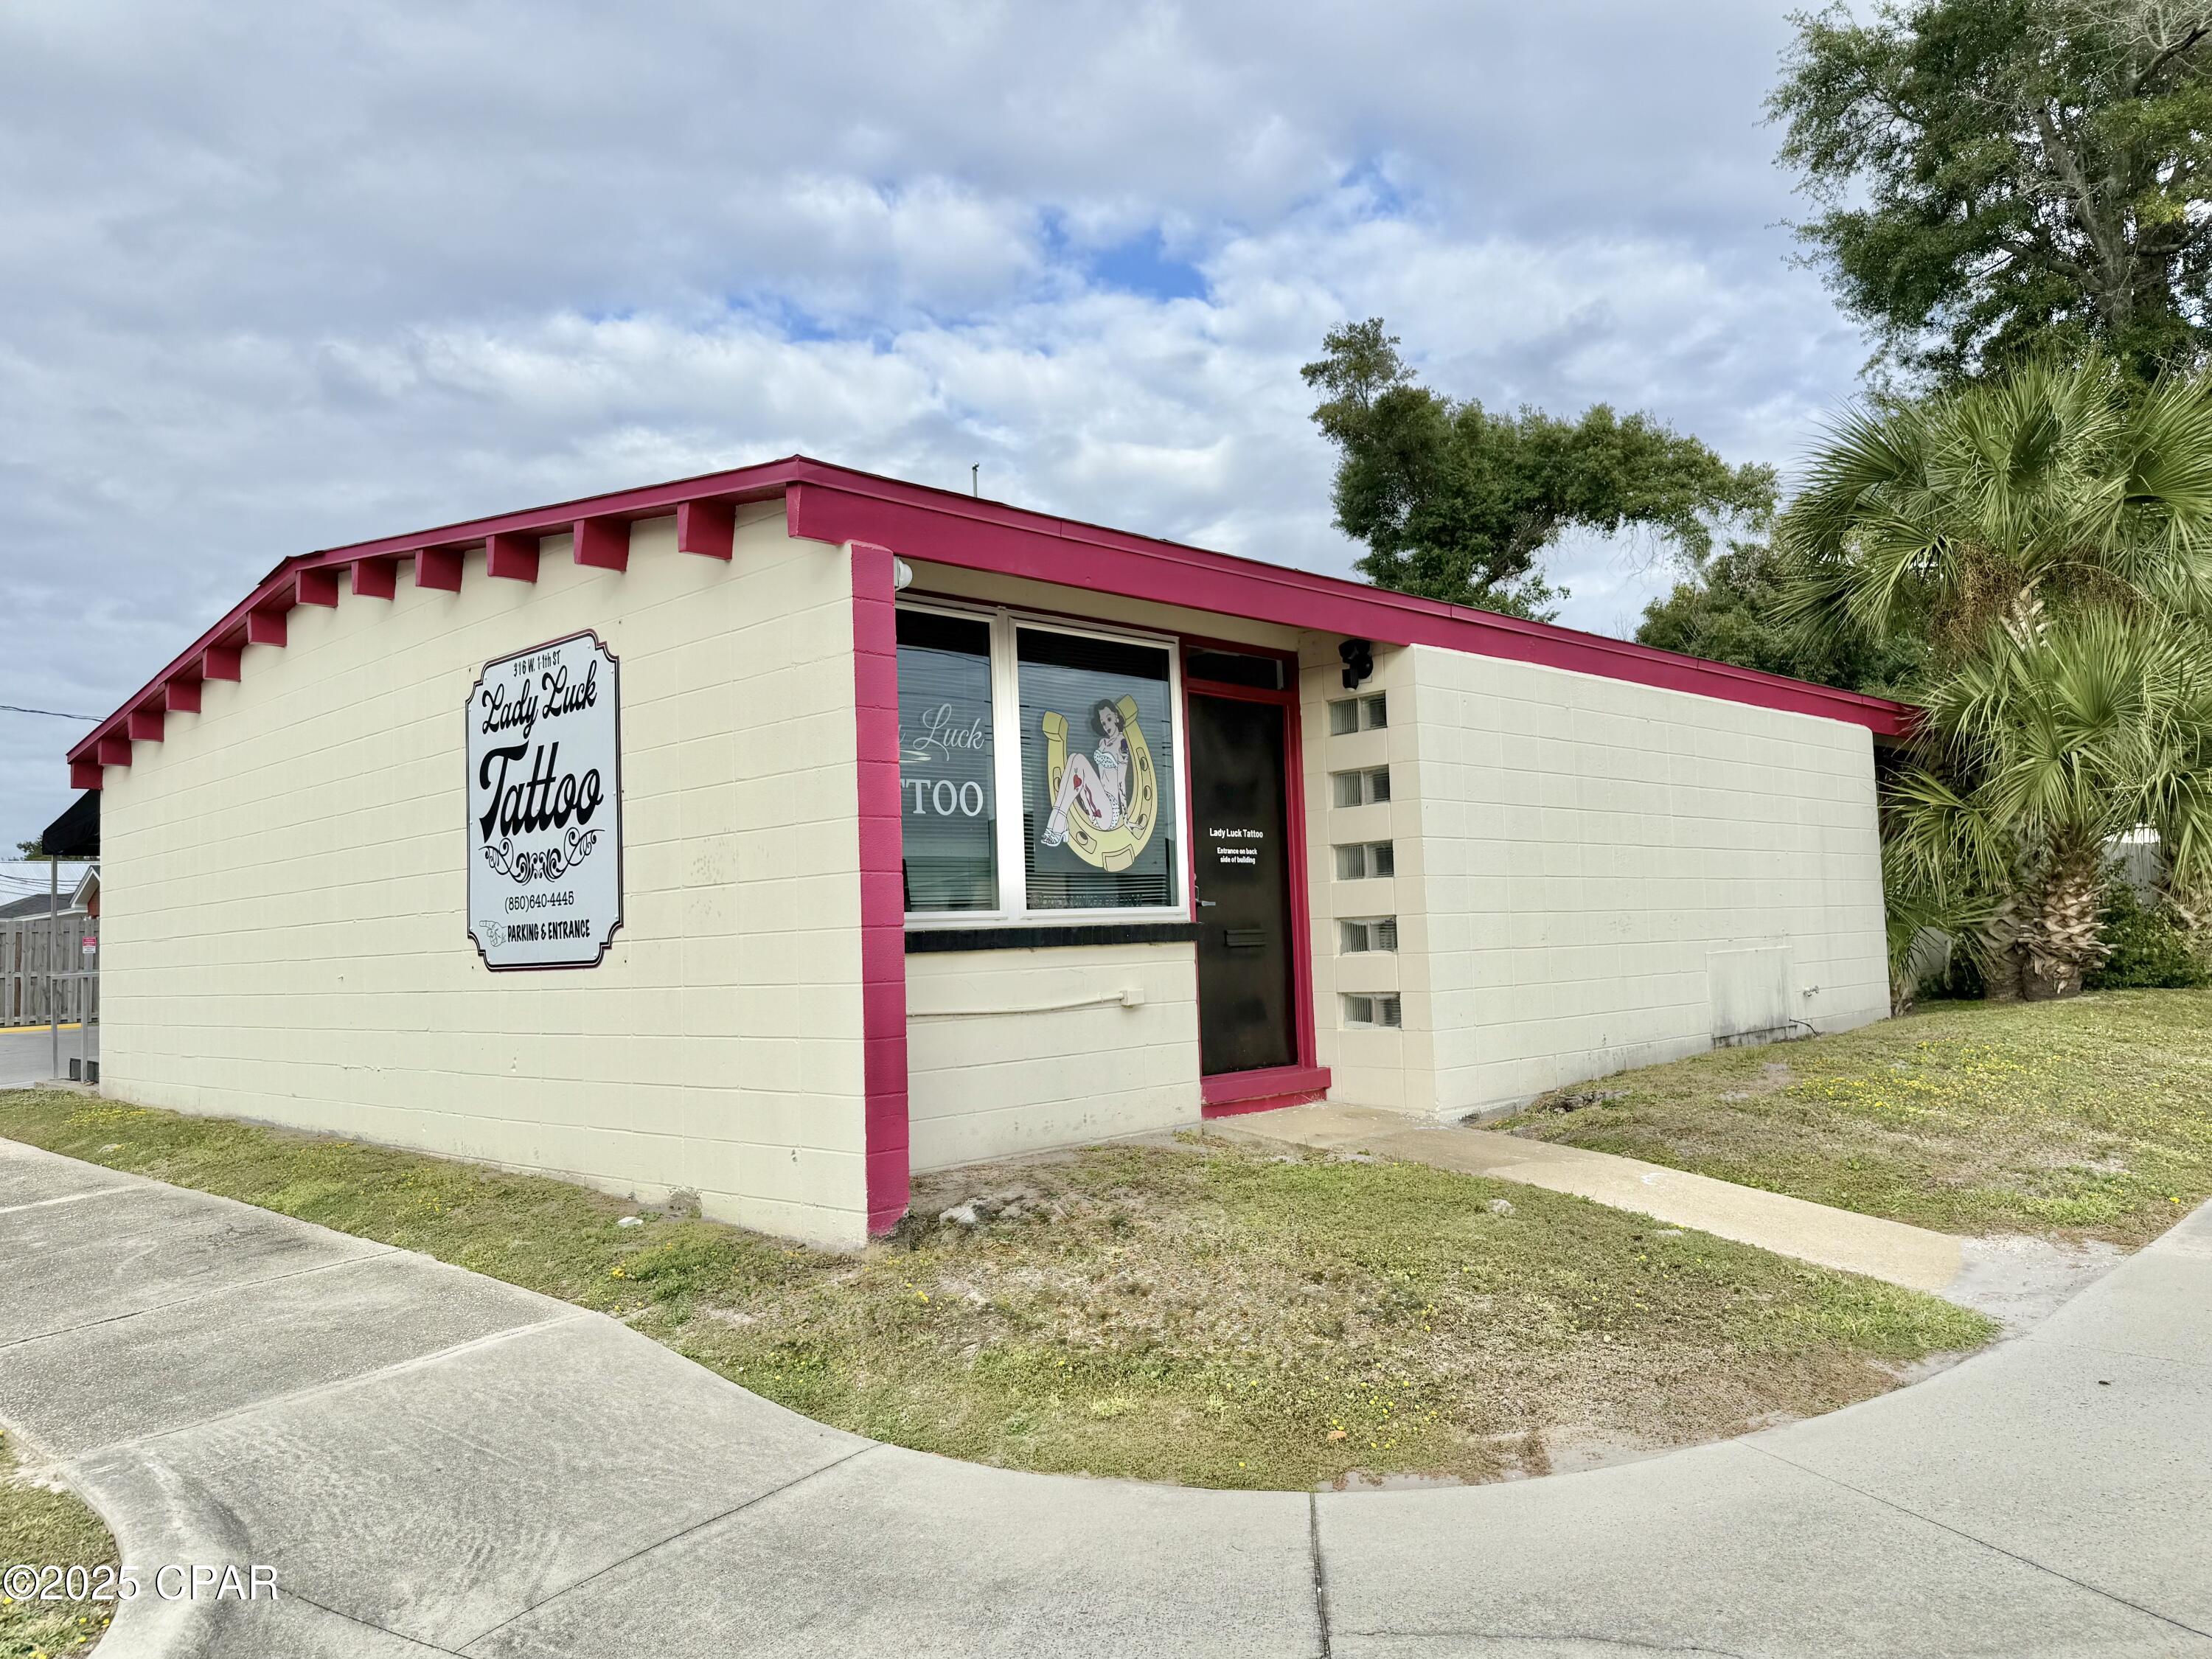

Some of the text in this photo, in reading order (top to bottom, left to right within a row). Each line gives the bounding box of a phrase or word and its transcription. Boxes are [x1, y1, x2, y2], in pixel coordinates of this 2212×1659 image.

[513, 649, 561, 677] 316 W. 11th ST
[481, 659, 597, 739] Lady Luck
[913, 703, 984, 762] Luck
[479, 739, 604, 844] Tattoo
[1209, 827, 1264, 839] Lady Luck Tattoo
[1217, 846, 1239, 855] Entrance
[1245, 847, 1258, 855] back
[1220, 855, 1231, 863] side
[1237, 856, 1256, 865] building
[504, 891, 574, 914] (850)640-4445
[507, 919, 591, 943] PARKING & ENTRANCE
